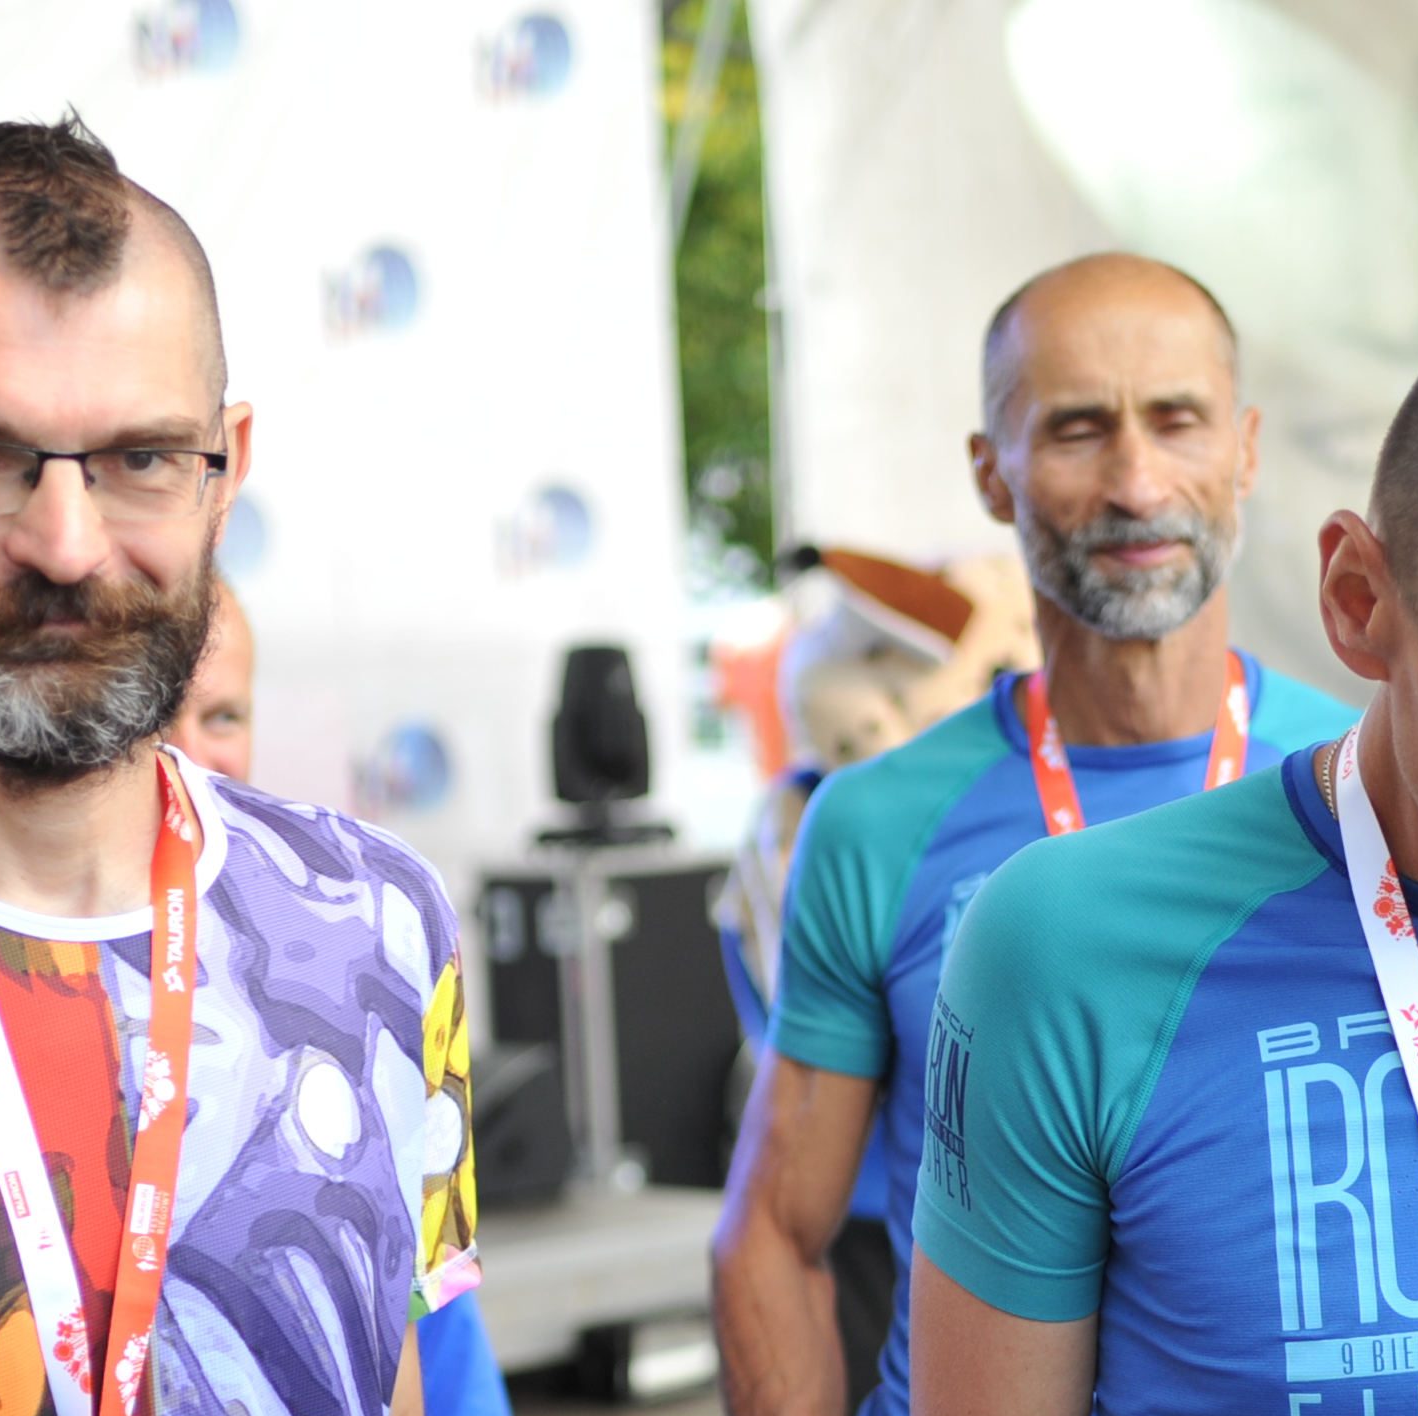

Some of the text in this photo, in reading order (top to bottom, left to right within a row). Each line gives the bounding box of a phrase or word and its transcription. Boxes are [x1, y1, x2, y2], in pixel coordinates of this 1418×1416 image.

[167, 889, 184, 962] TAURON
[157, 1191, 171, 1235] BIEGOWY
[1341, 1343, 1355, 1375] 9
